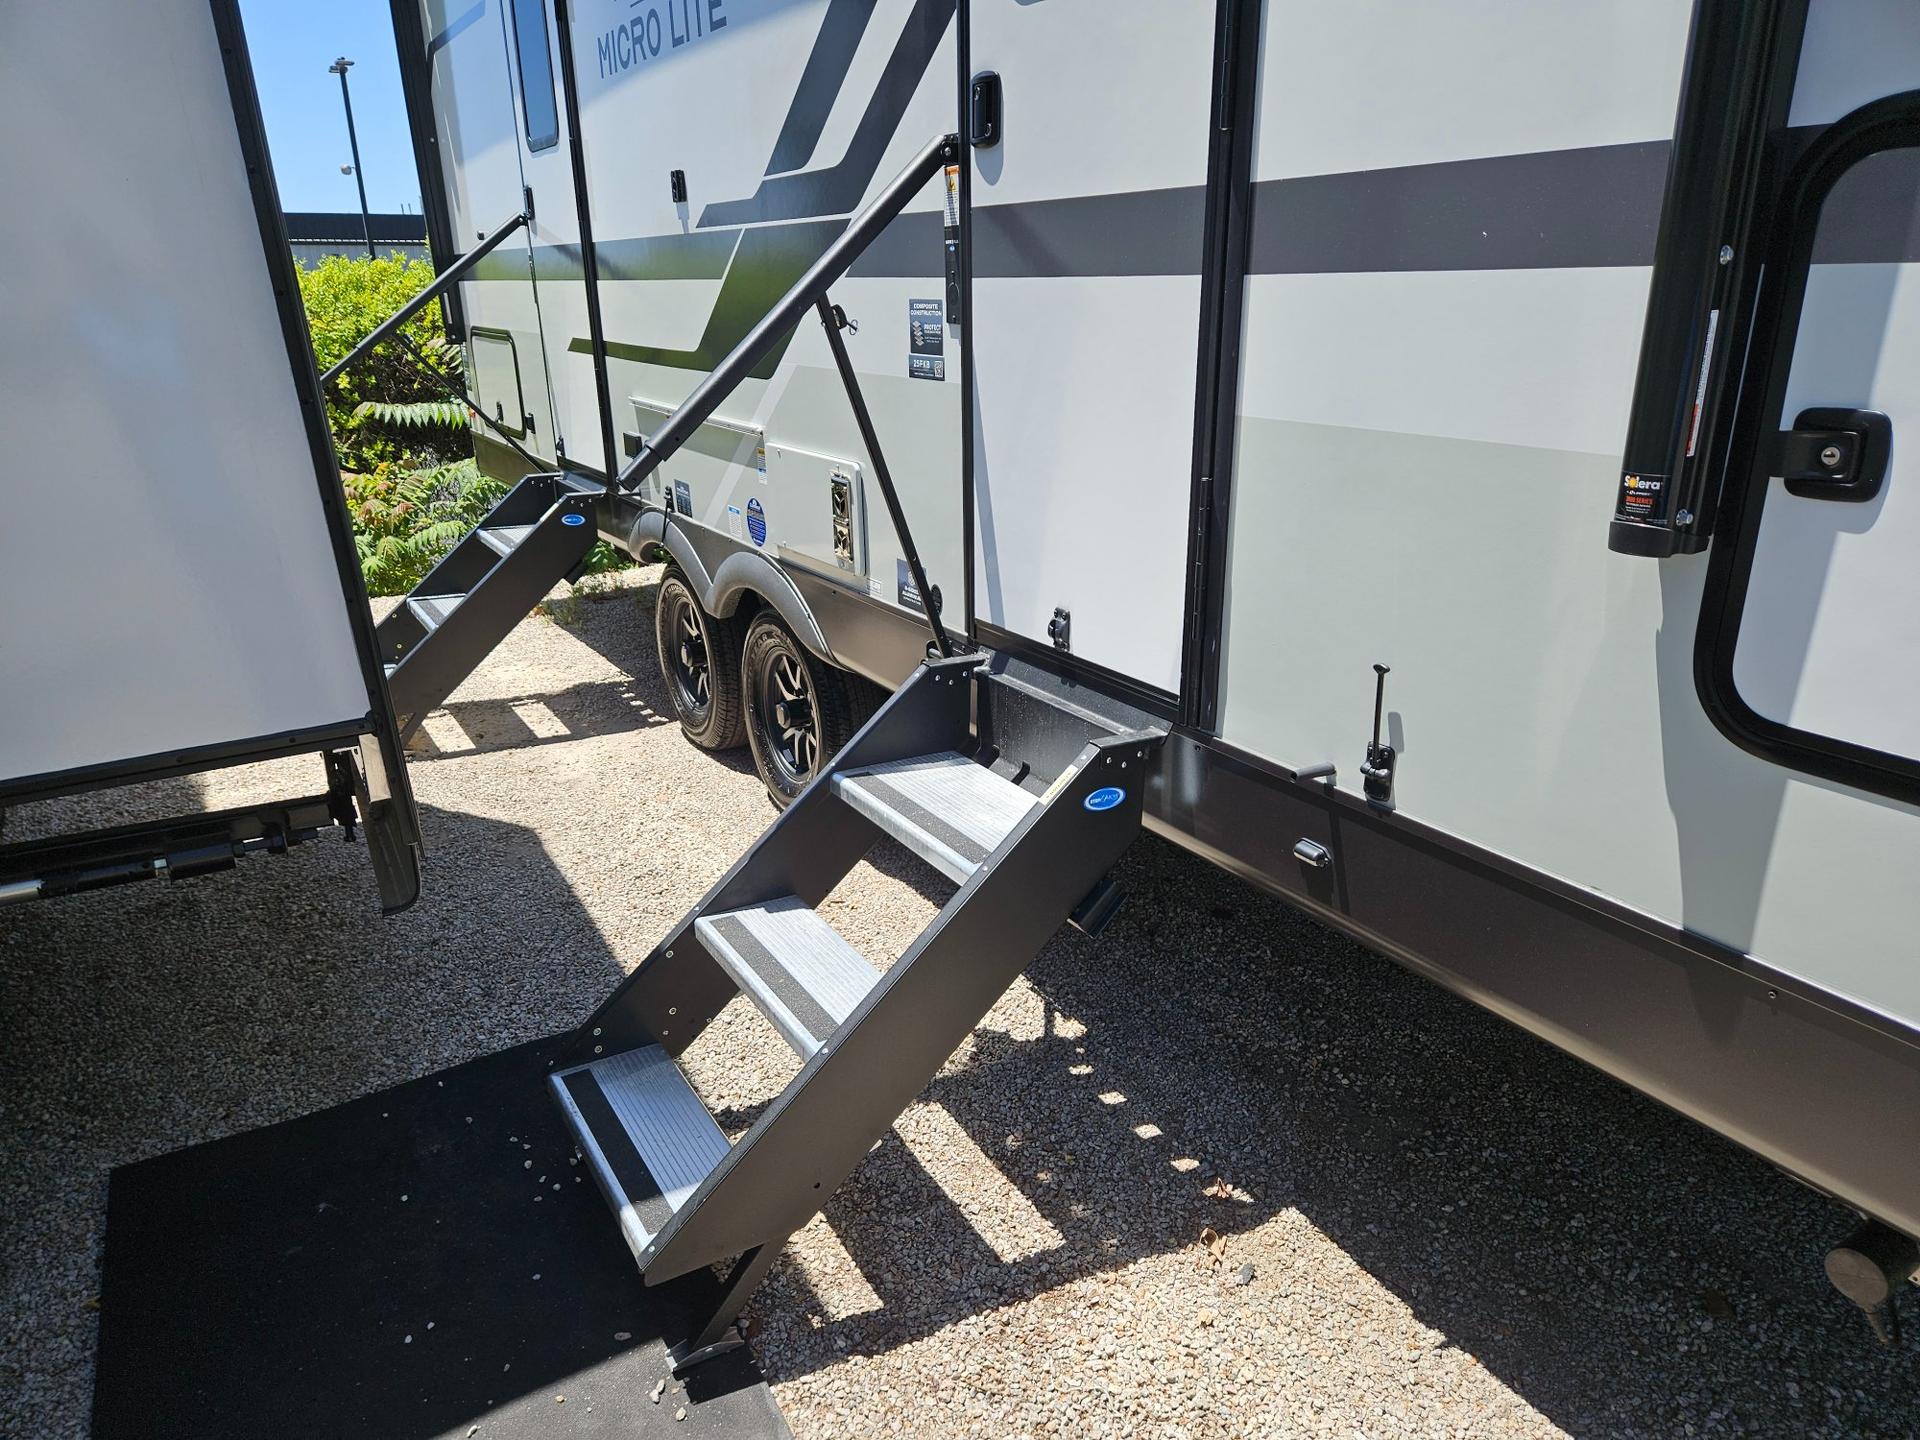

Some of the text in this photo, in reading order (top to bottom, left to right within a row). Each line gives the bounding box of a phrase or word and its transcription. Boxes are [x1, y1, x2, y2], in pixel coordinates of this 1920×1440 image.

[597, 0, 727, 79] MICRO LITE
[1624, 474, 1661, 490] Solera
